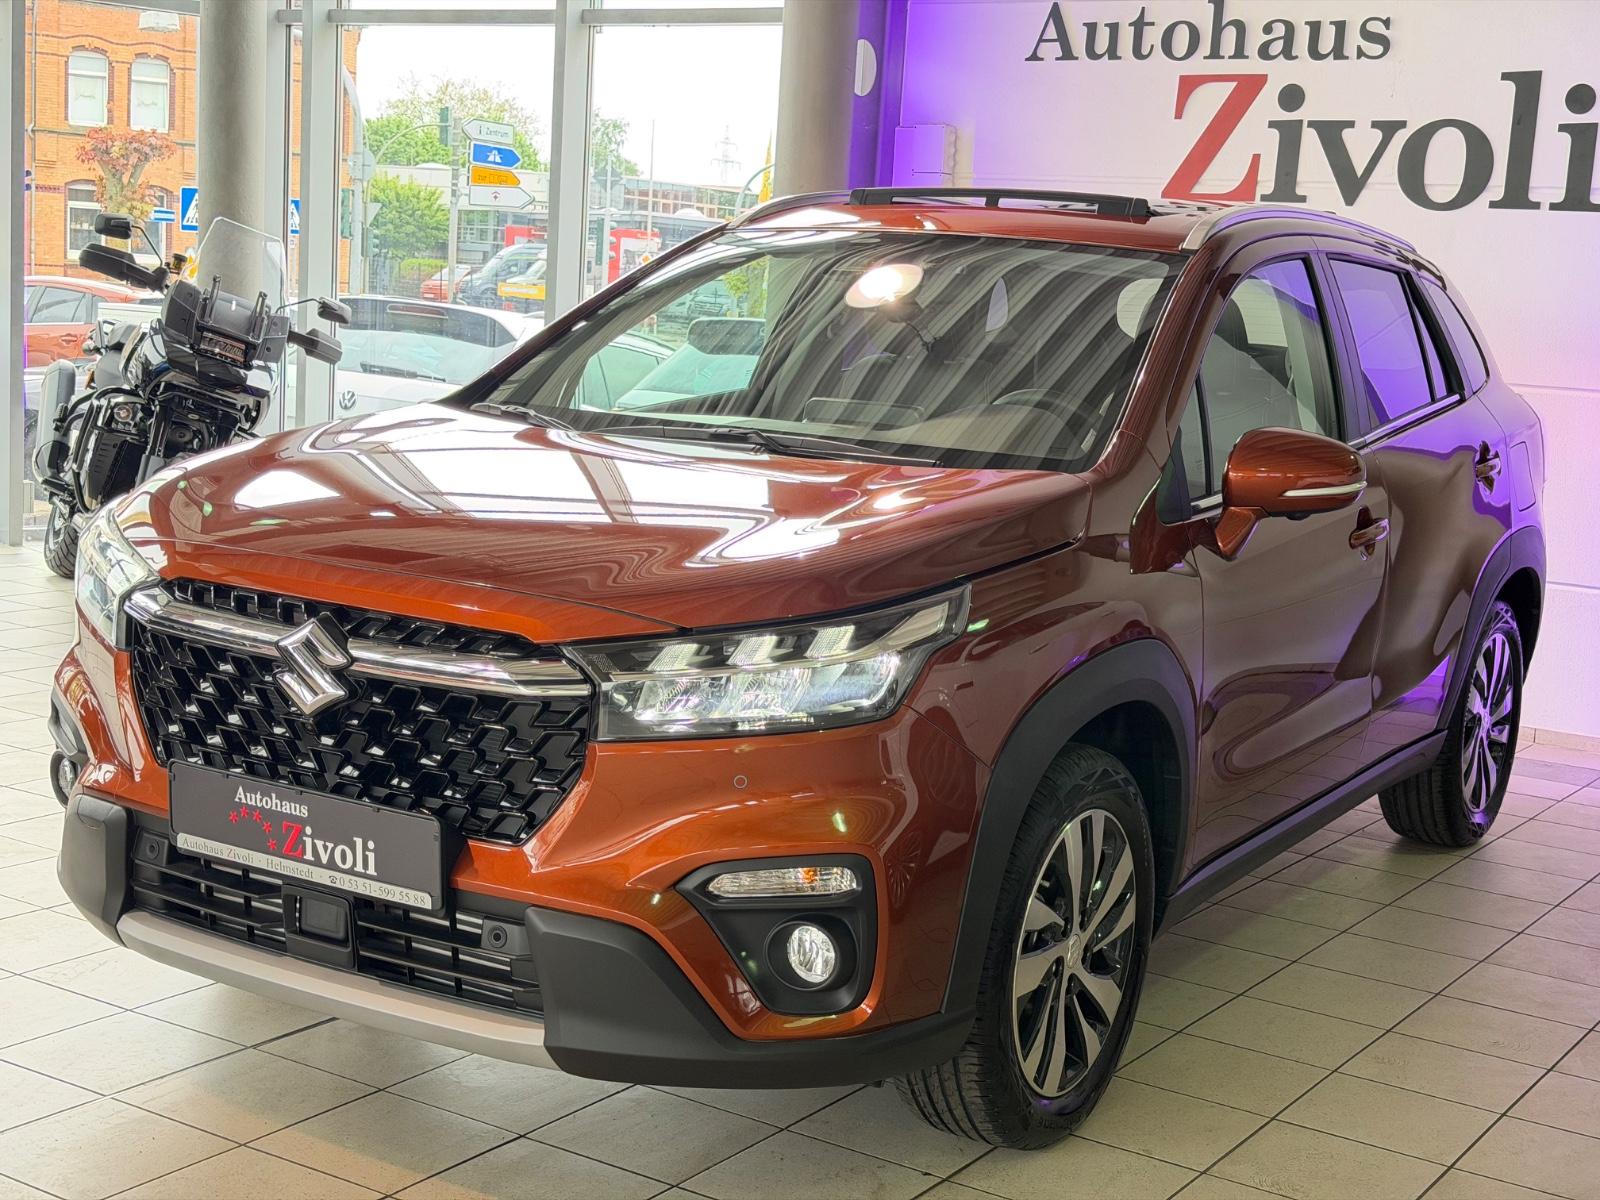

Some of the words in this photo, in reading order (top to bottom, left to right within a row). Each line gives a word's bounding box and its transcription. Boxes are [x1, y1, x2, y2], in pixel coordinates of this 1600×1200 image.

[1024, 0, 1392, 62] Autohaus
[485, 127, 509, 138] Zentrum
[1160, 70, 1600, 212] Zivoli
[234, 785, 309, 818] Autohaus
[182, 837, 224, 857] Autohaus
[226, 847, 254, 864] Zivoli
[266, 857, 314, 880] Helmstedt
[281, 820, 378, 876] Zivoli
